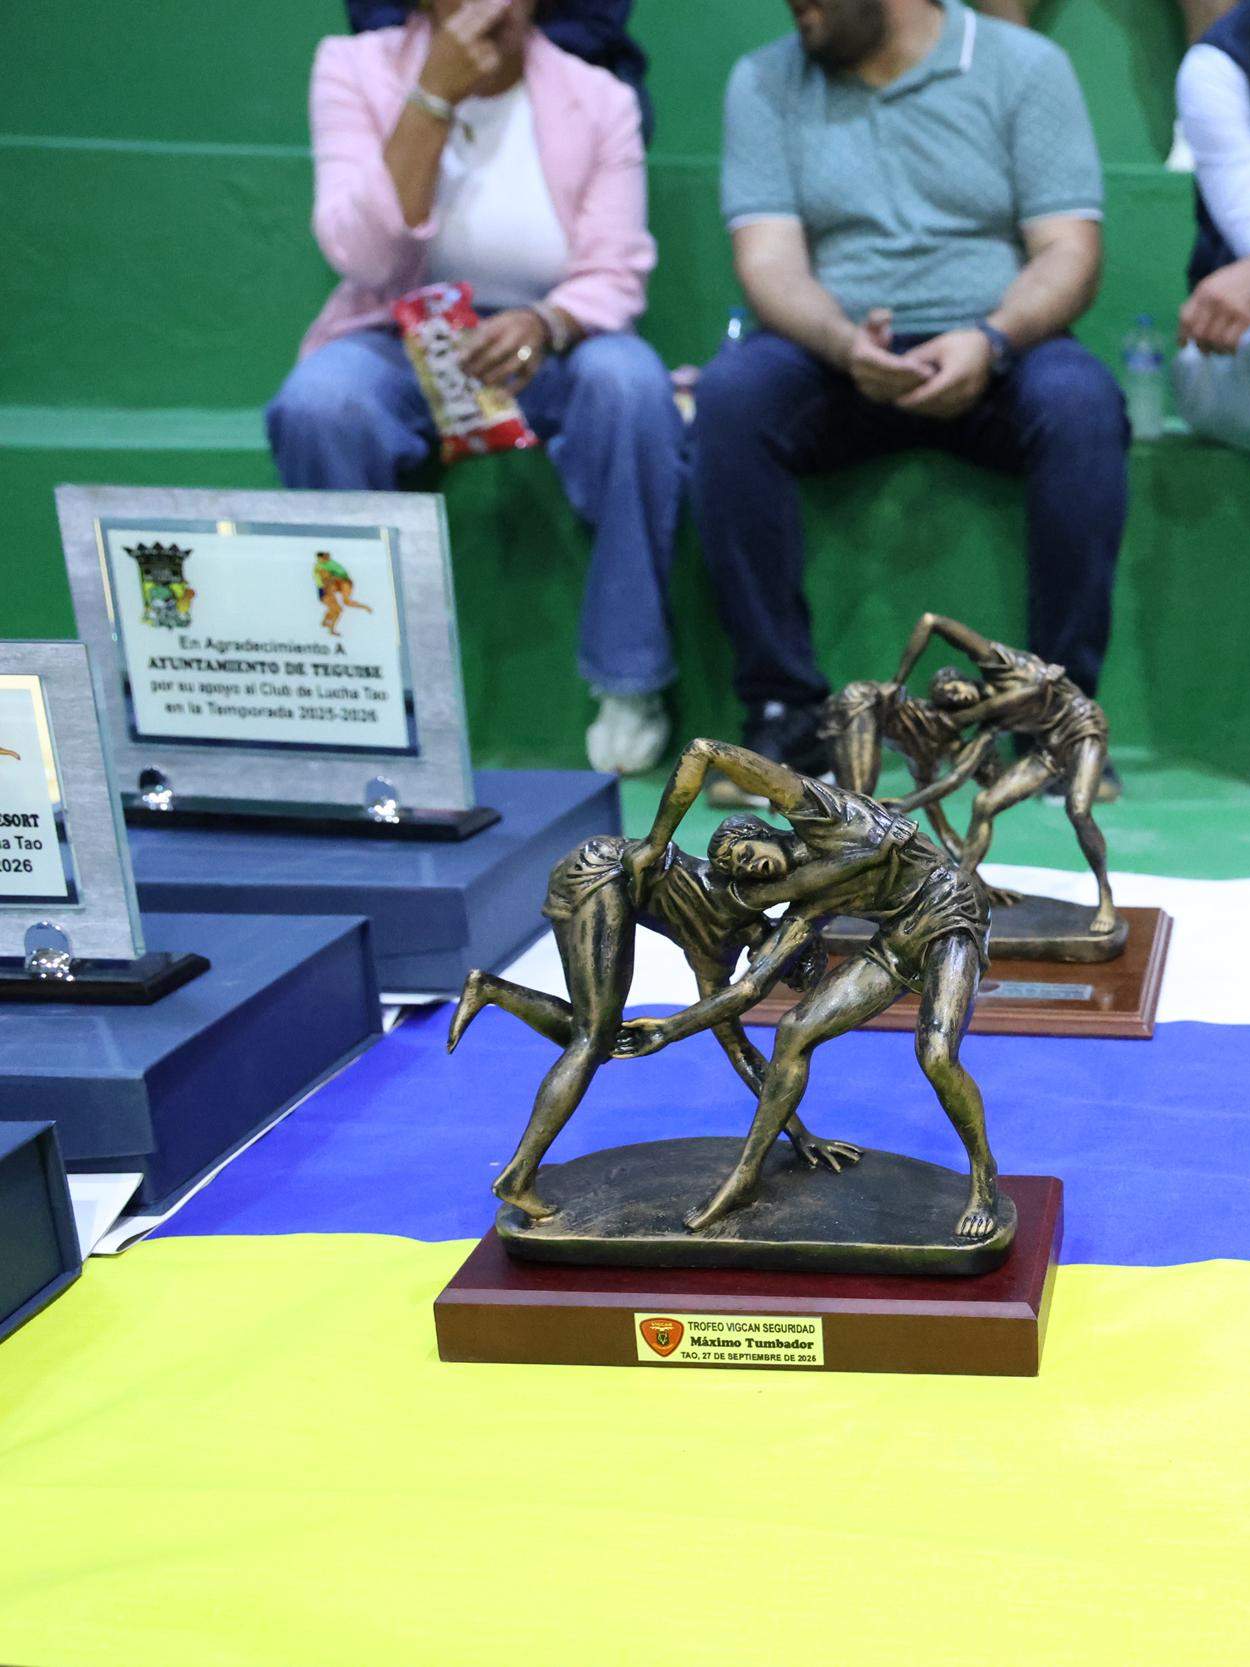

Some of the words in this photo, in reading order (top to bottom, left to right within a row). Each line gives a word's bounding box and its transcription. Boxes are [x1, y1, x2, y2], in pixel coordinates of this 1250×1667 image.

[179, 635, 201, 650] En
[205, 637, 331, 655] Agradecimiento
[335, 643, 346, 655] A
[148, 656, 280, 674] AYUNTAMIENTO
[285, 662, 306, 676] DE
[151, 681, 173, 695] por
[178, 682, 194, 693] su
[259, 682, 290, 697] Club
[297, 685, 312, 698] de
[316, 685, 359, 700] Lucha
[362, 686, 388, 702] Tao
[165, 703, 184, 713] en
[187, 702, 202, 714] la
[206, 701, 294, 719] Temporada
[0, 813, 39, 828] SORT
[14, 835, 43, 850] Tao
[0, 858, 33, 873] 026
[688, 1321, 725, 1332] TROFEO
[726, 1322, 761, 1333] VIGCAN
[762, 1323, 816, 1334] SEGURIDAD
[690, 1336, 742, 1348] Máximo
[745, 1338, 815, 1349] Tumbador
[680, 1351, 700, 1360] TAO,
[702, 1352, 712, 1360] 27
[714, 1352, 726, 1360] DE
[727, 1353, 782, 1361] SEPTIEMBRE
[783, 1354, 796, 1362] DE
